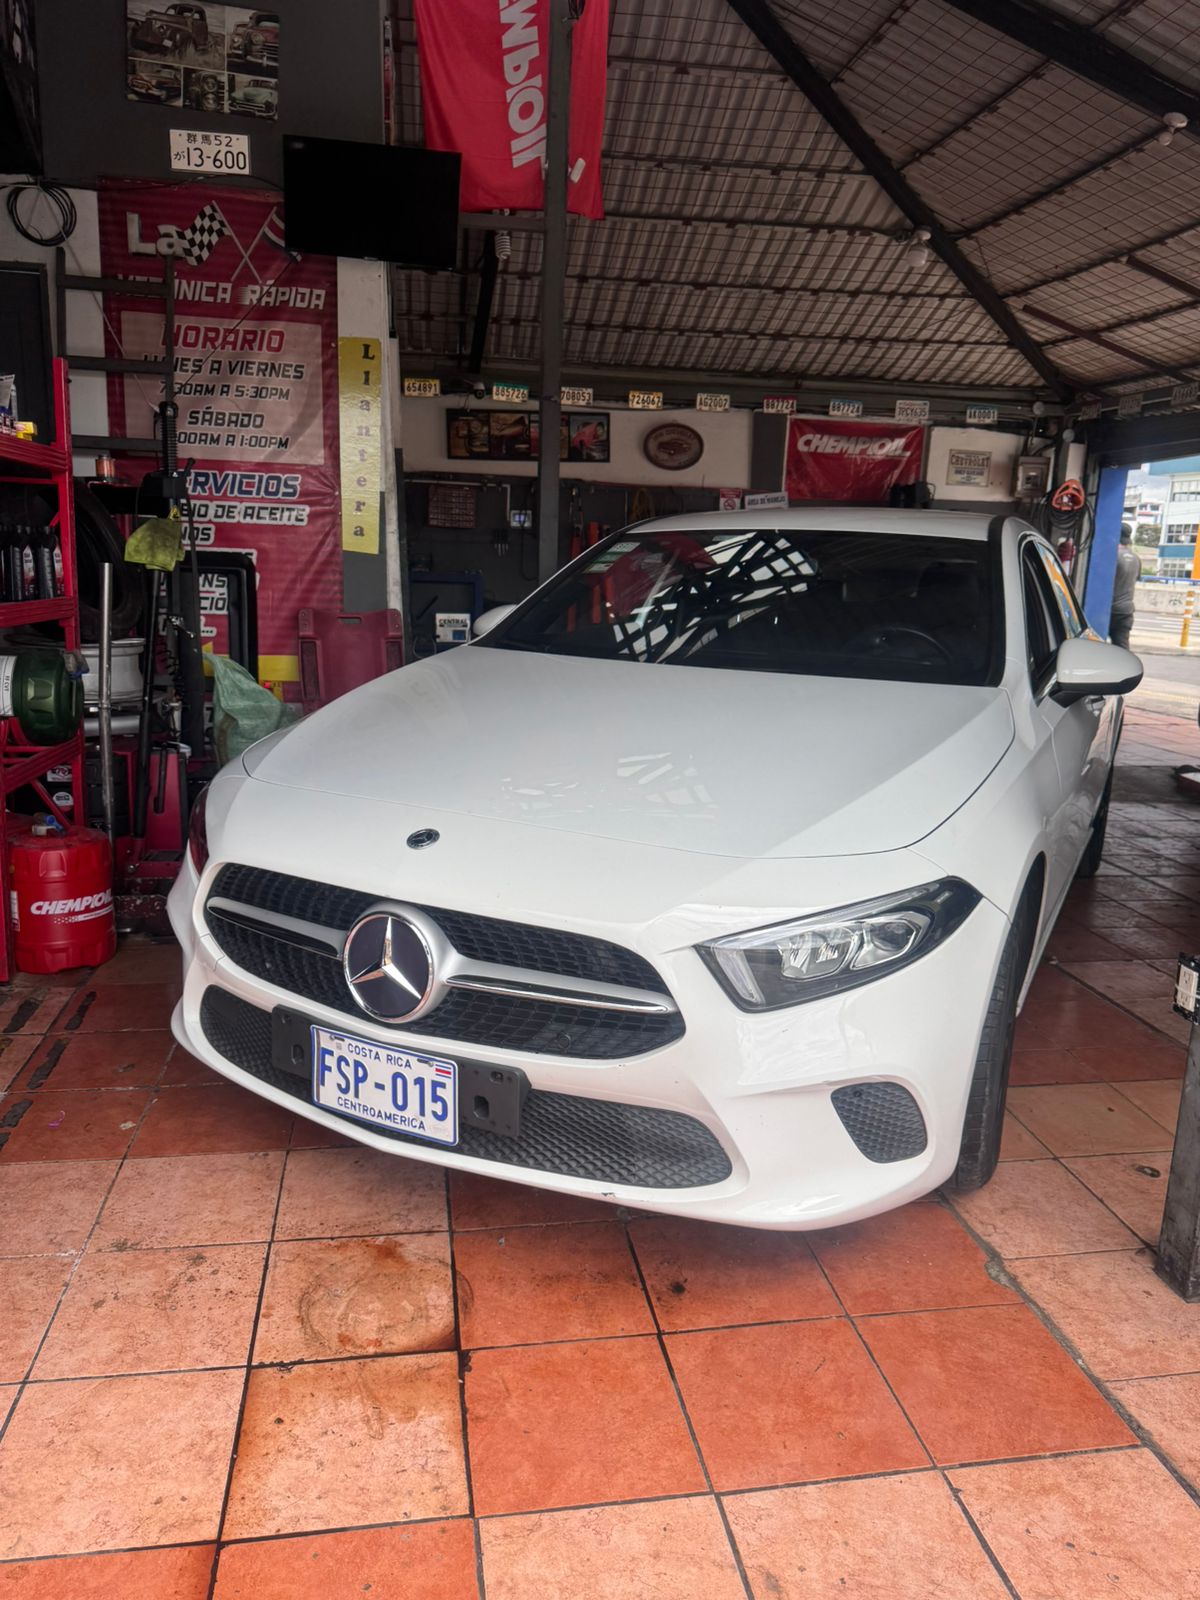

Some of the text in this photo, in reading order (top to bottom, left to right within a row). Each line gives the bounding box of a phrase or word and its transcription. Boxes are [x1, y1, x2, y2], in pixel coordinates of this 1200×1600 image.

[245, 280, 326, 310] RÁPIDA
[209, 359, 222, 376] A
[228, 360, 305, 379] VIERNES
[160, 380, 290, 401] 730AM A 5:30PM
[187, 406, 265, 429] SÁBADO
[225, 434, 236, 447] A
[240, 434, 289, 449] 1:00PM
[188, 470, 301, 499] RVICIOS
[214, 504, 238, 520] DE
[242, 505, 307, 522] ACEITE
[347, 1042, 413, 1070] COSTA RICA
[320, 1047, 449, 1122] FSP-015
[336, 1096, 426, 1132] CENTROAMERICA
